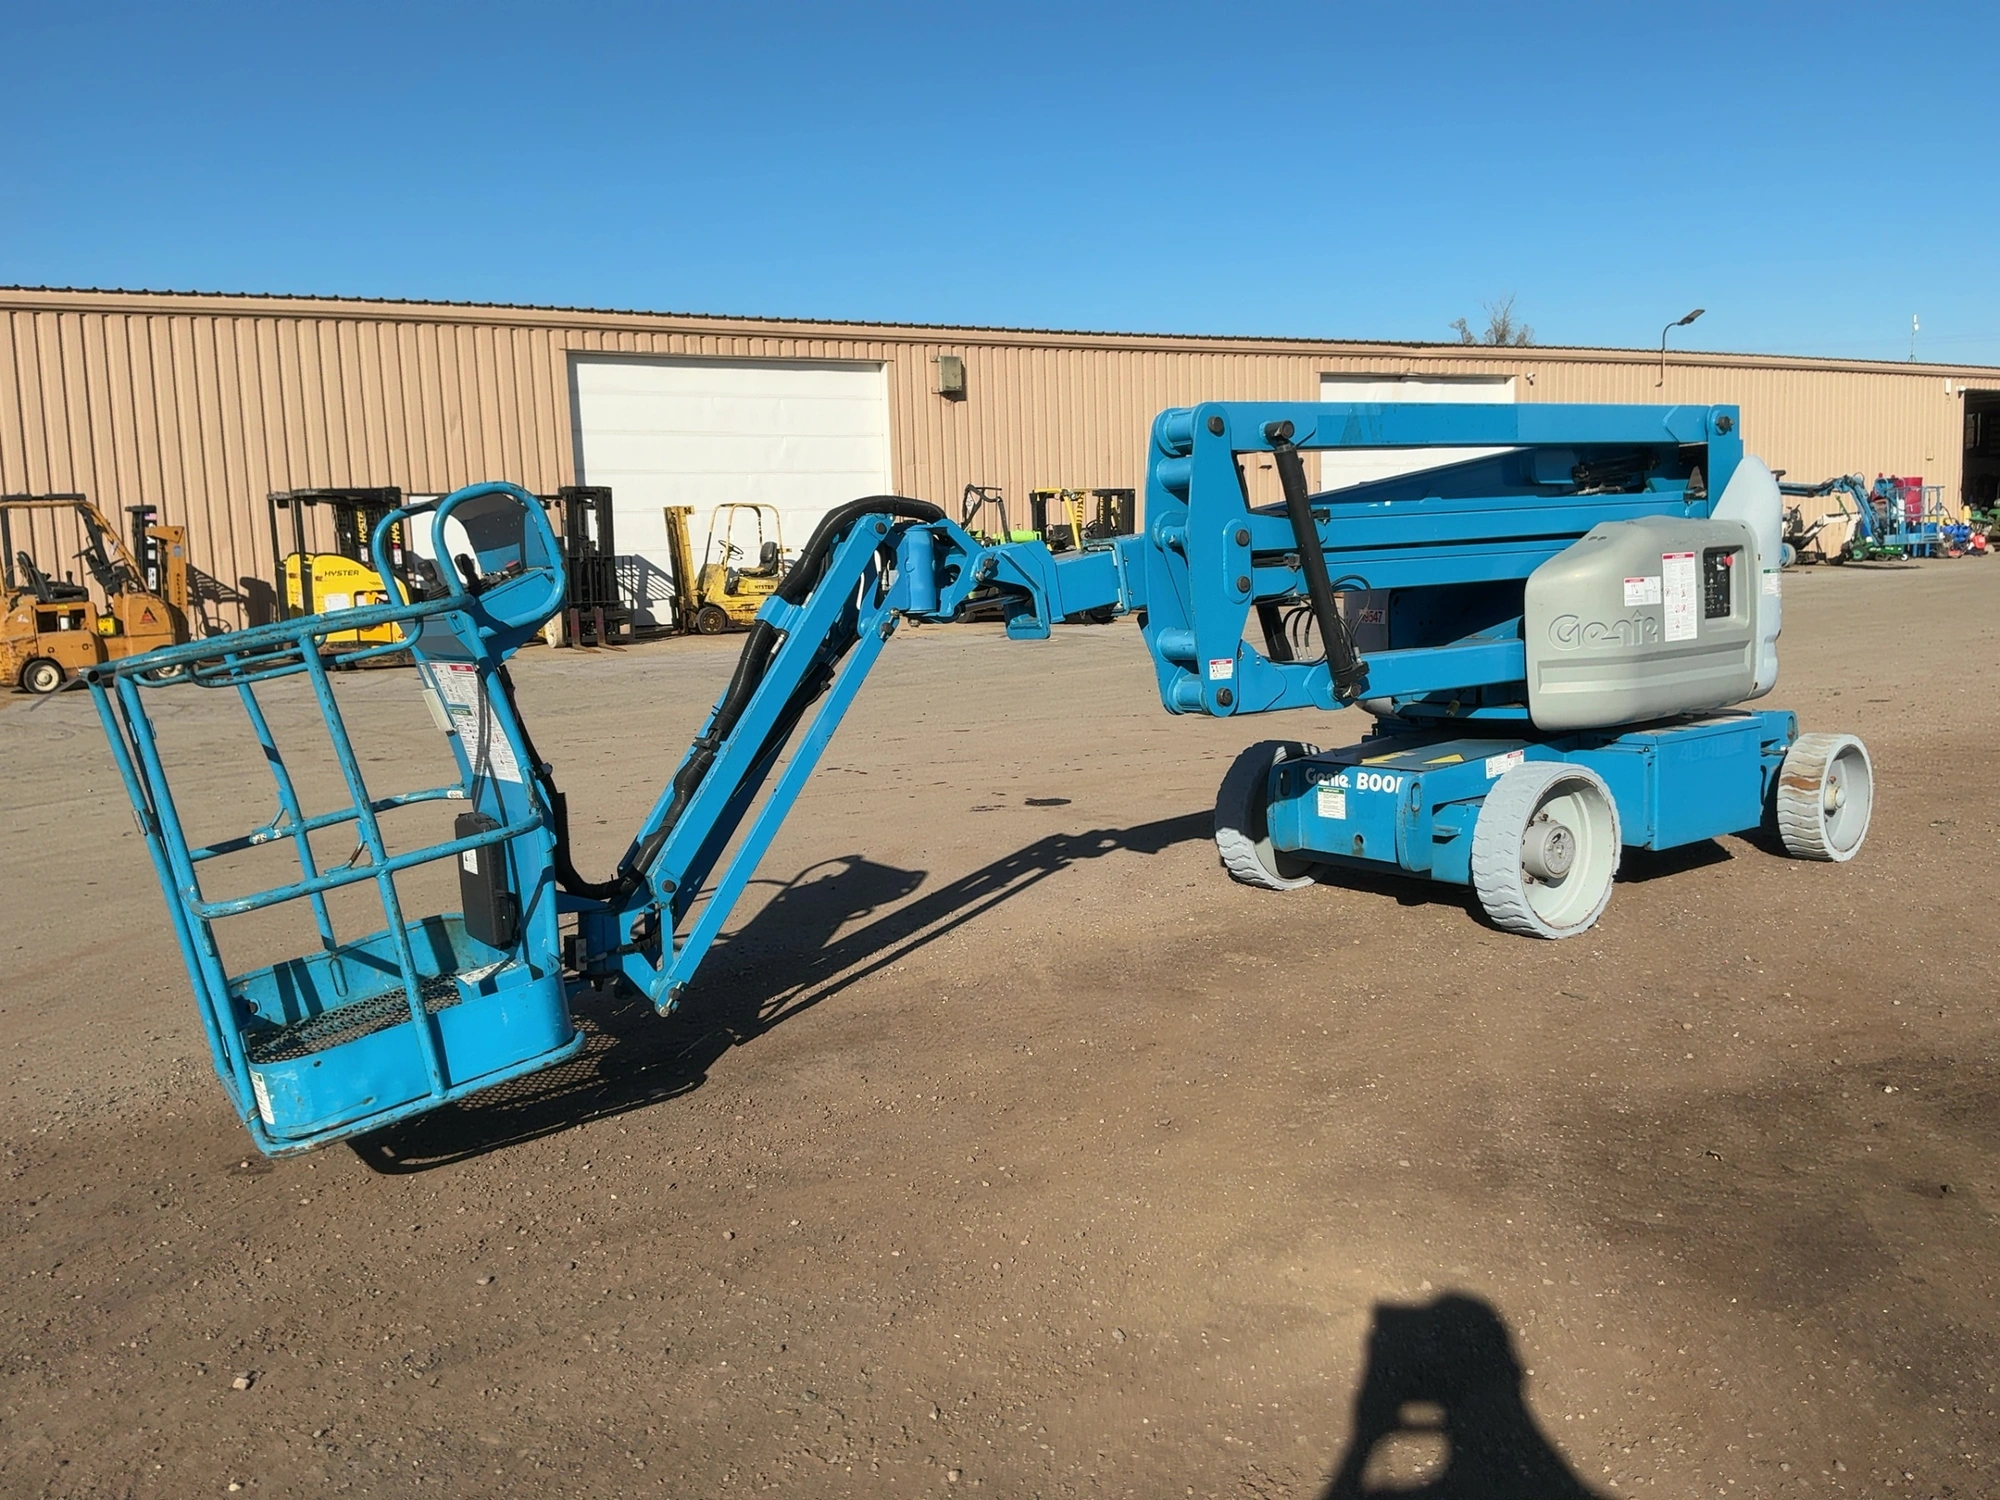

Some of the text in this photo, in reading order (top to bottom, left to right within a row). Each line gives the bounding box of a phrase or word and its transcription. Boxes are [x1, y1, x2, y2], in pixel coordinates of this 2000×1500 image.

[325, 569, 360, 577] HYSTER
[1548, 610, 1659, 651] Genie
[1305, 767, 1349, 788] Genie
